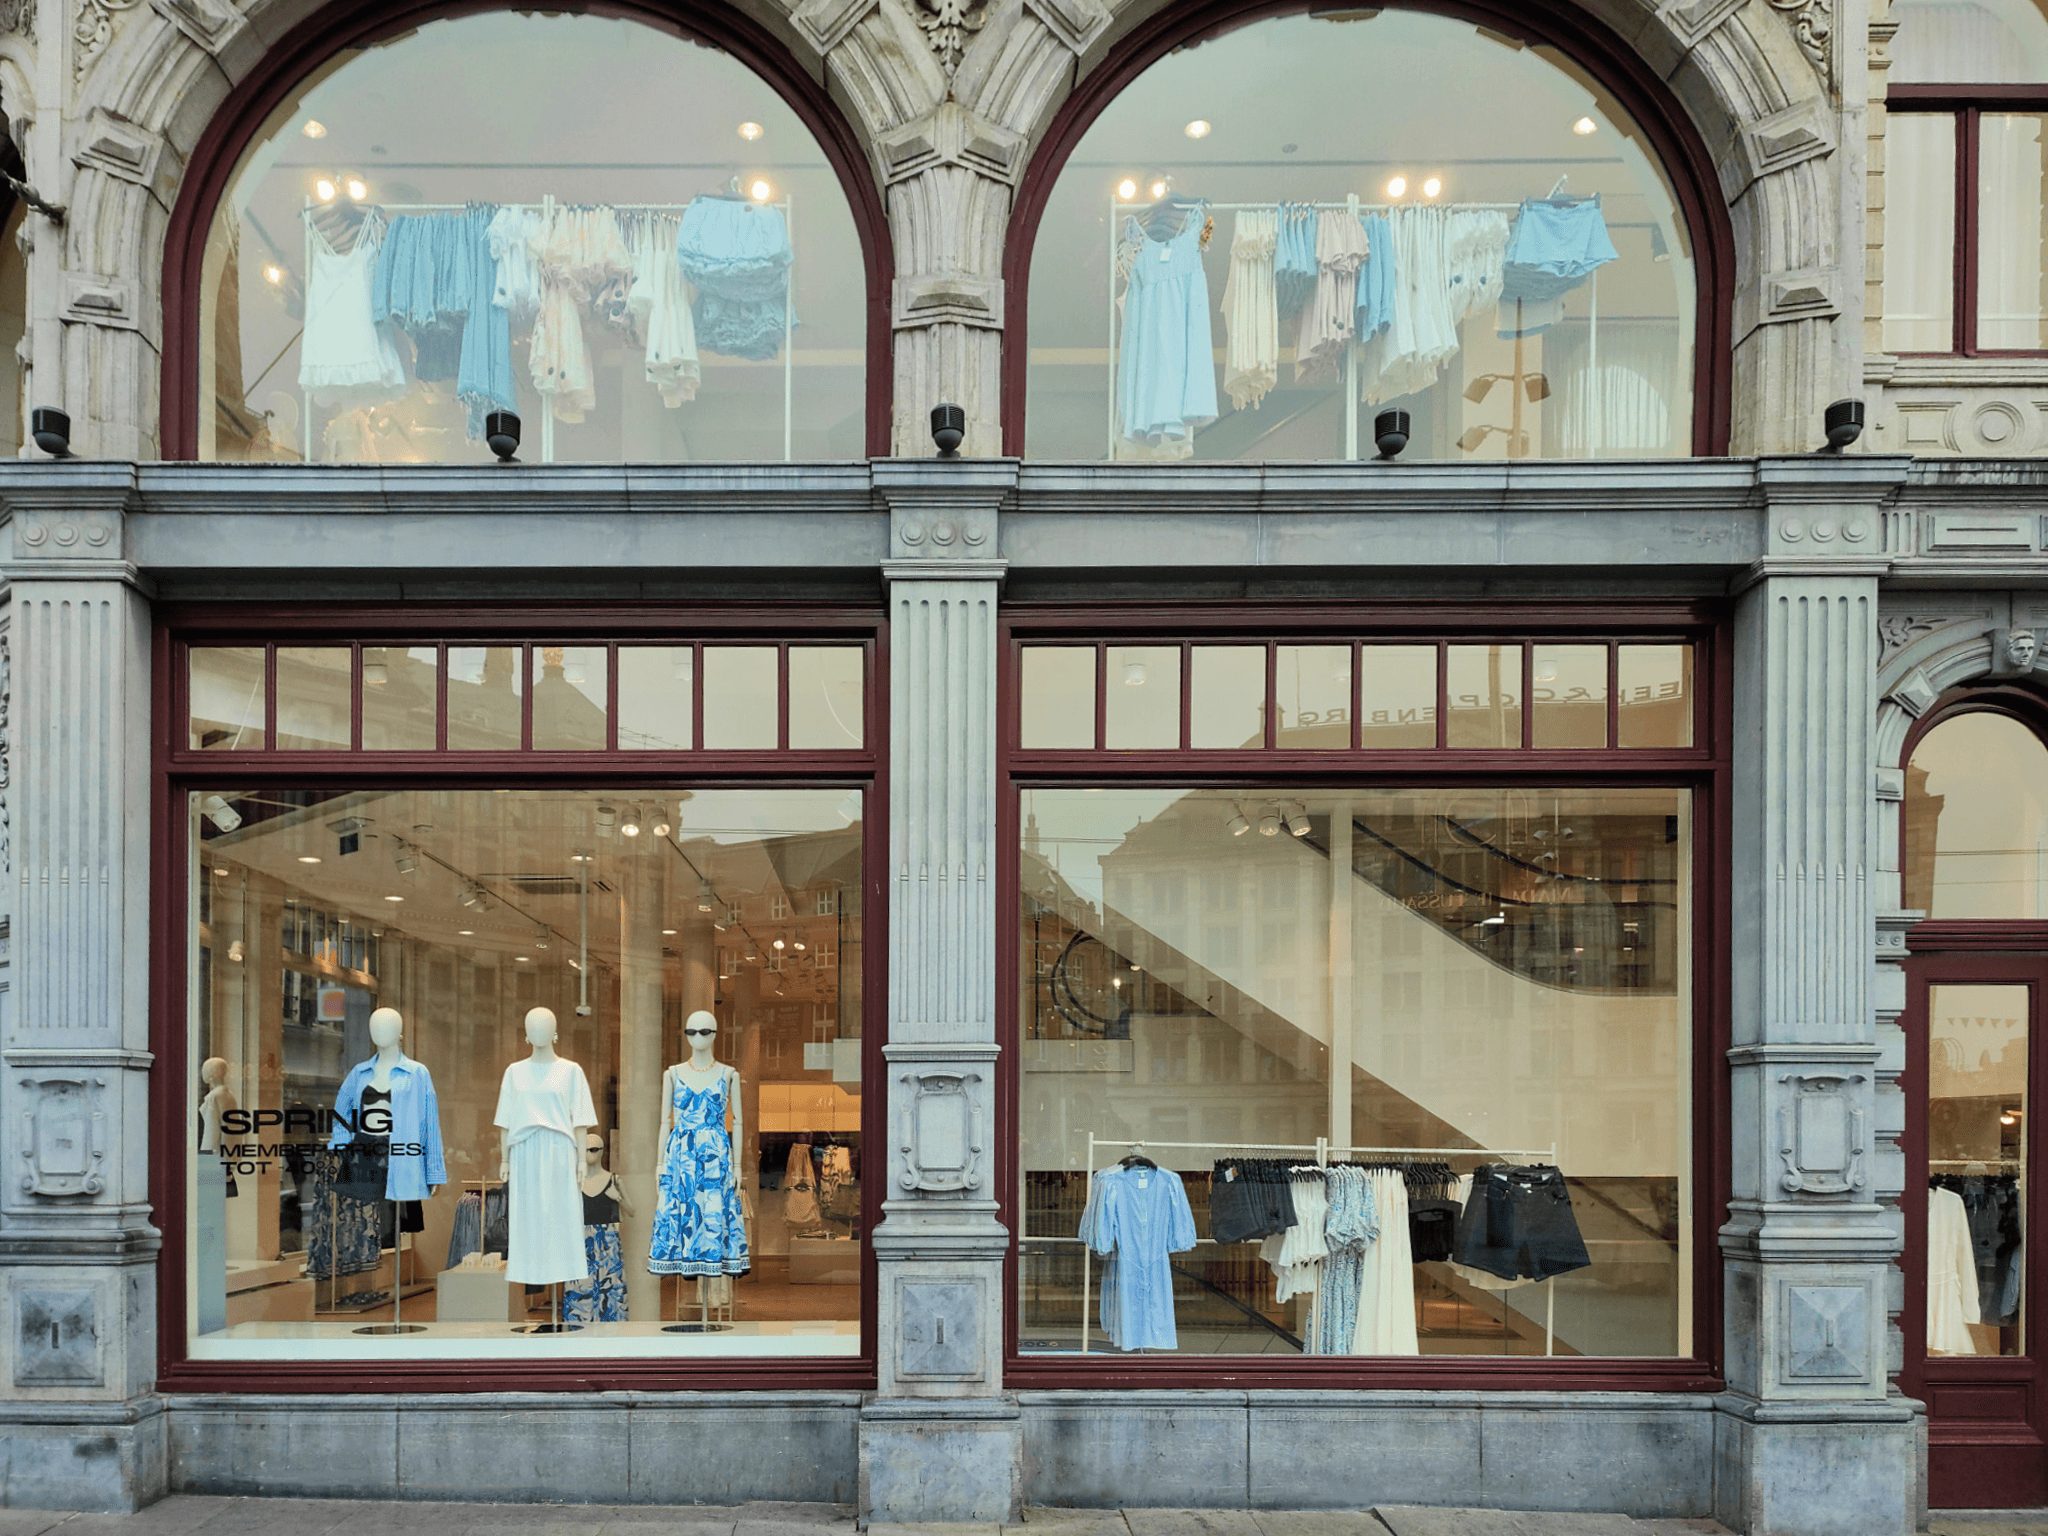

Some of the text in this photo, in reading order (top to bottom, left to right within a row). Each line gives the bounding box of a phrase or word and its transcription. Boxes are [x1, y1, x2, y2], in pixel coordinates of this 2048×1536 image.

[220, 1108, 393, 1135] SPRING
[220, 1142, 426, 1157] MEMBER PRICES:
[220, 1161, 272, 1175] TOT
